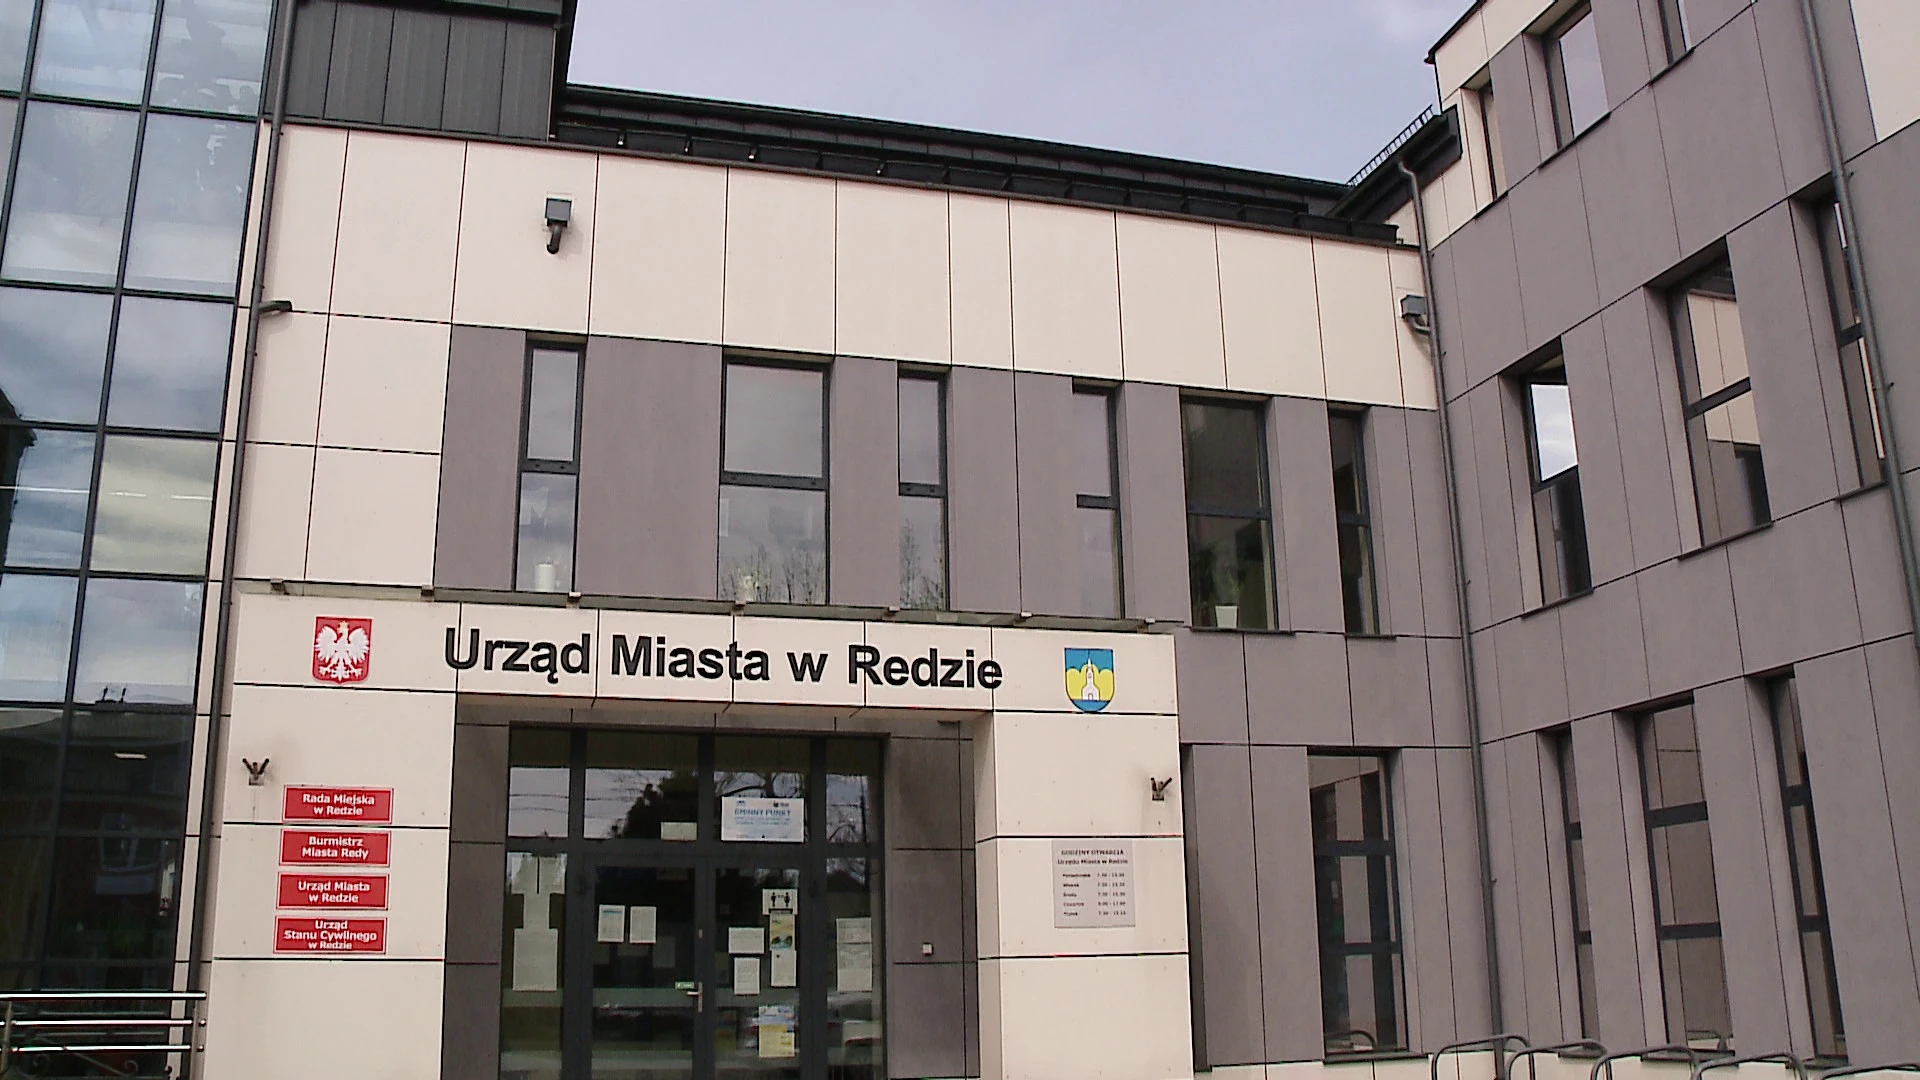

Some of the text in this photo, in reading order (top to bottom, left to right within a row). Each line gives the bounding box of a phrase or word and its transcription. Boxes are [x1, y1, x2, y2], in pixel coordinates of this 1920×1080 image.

[444, 627, 1003, 690] Urząd Miasta w Redzie
[302, 793, 375, 807] Rada Miejska
[313, 805, 363, 815] w Redzie
[308, 835, 364, 847] Burmistrz
[302, 847, 369, 860] Miasta Redy
[298, 880, 370, 893] Urząd Miasta
[308, 893, 359, 903] w Redzie
[315, 919, 349, 931] Urząd
[284, 930, 377, 943] Stanu Cywilnego
[308, 940, 353, 950] w Redzie
